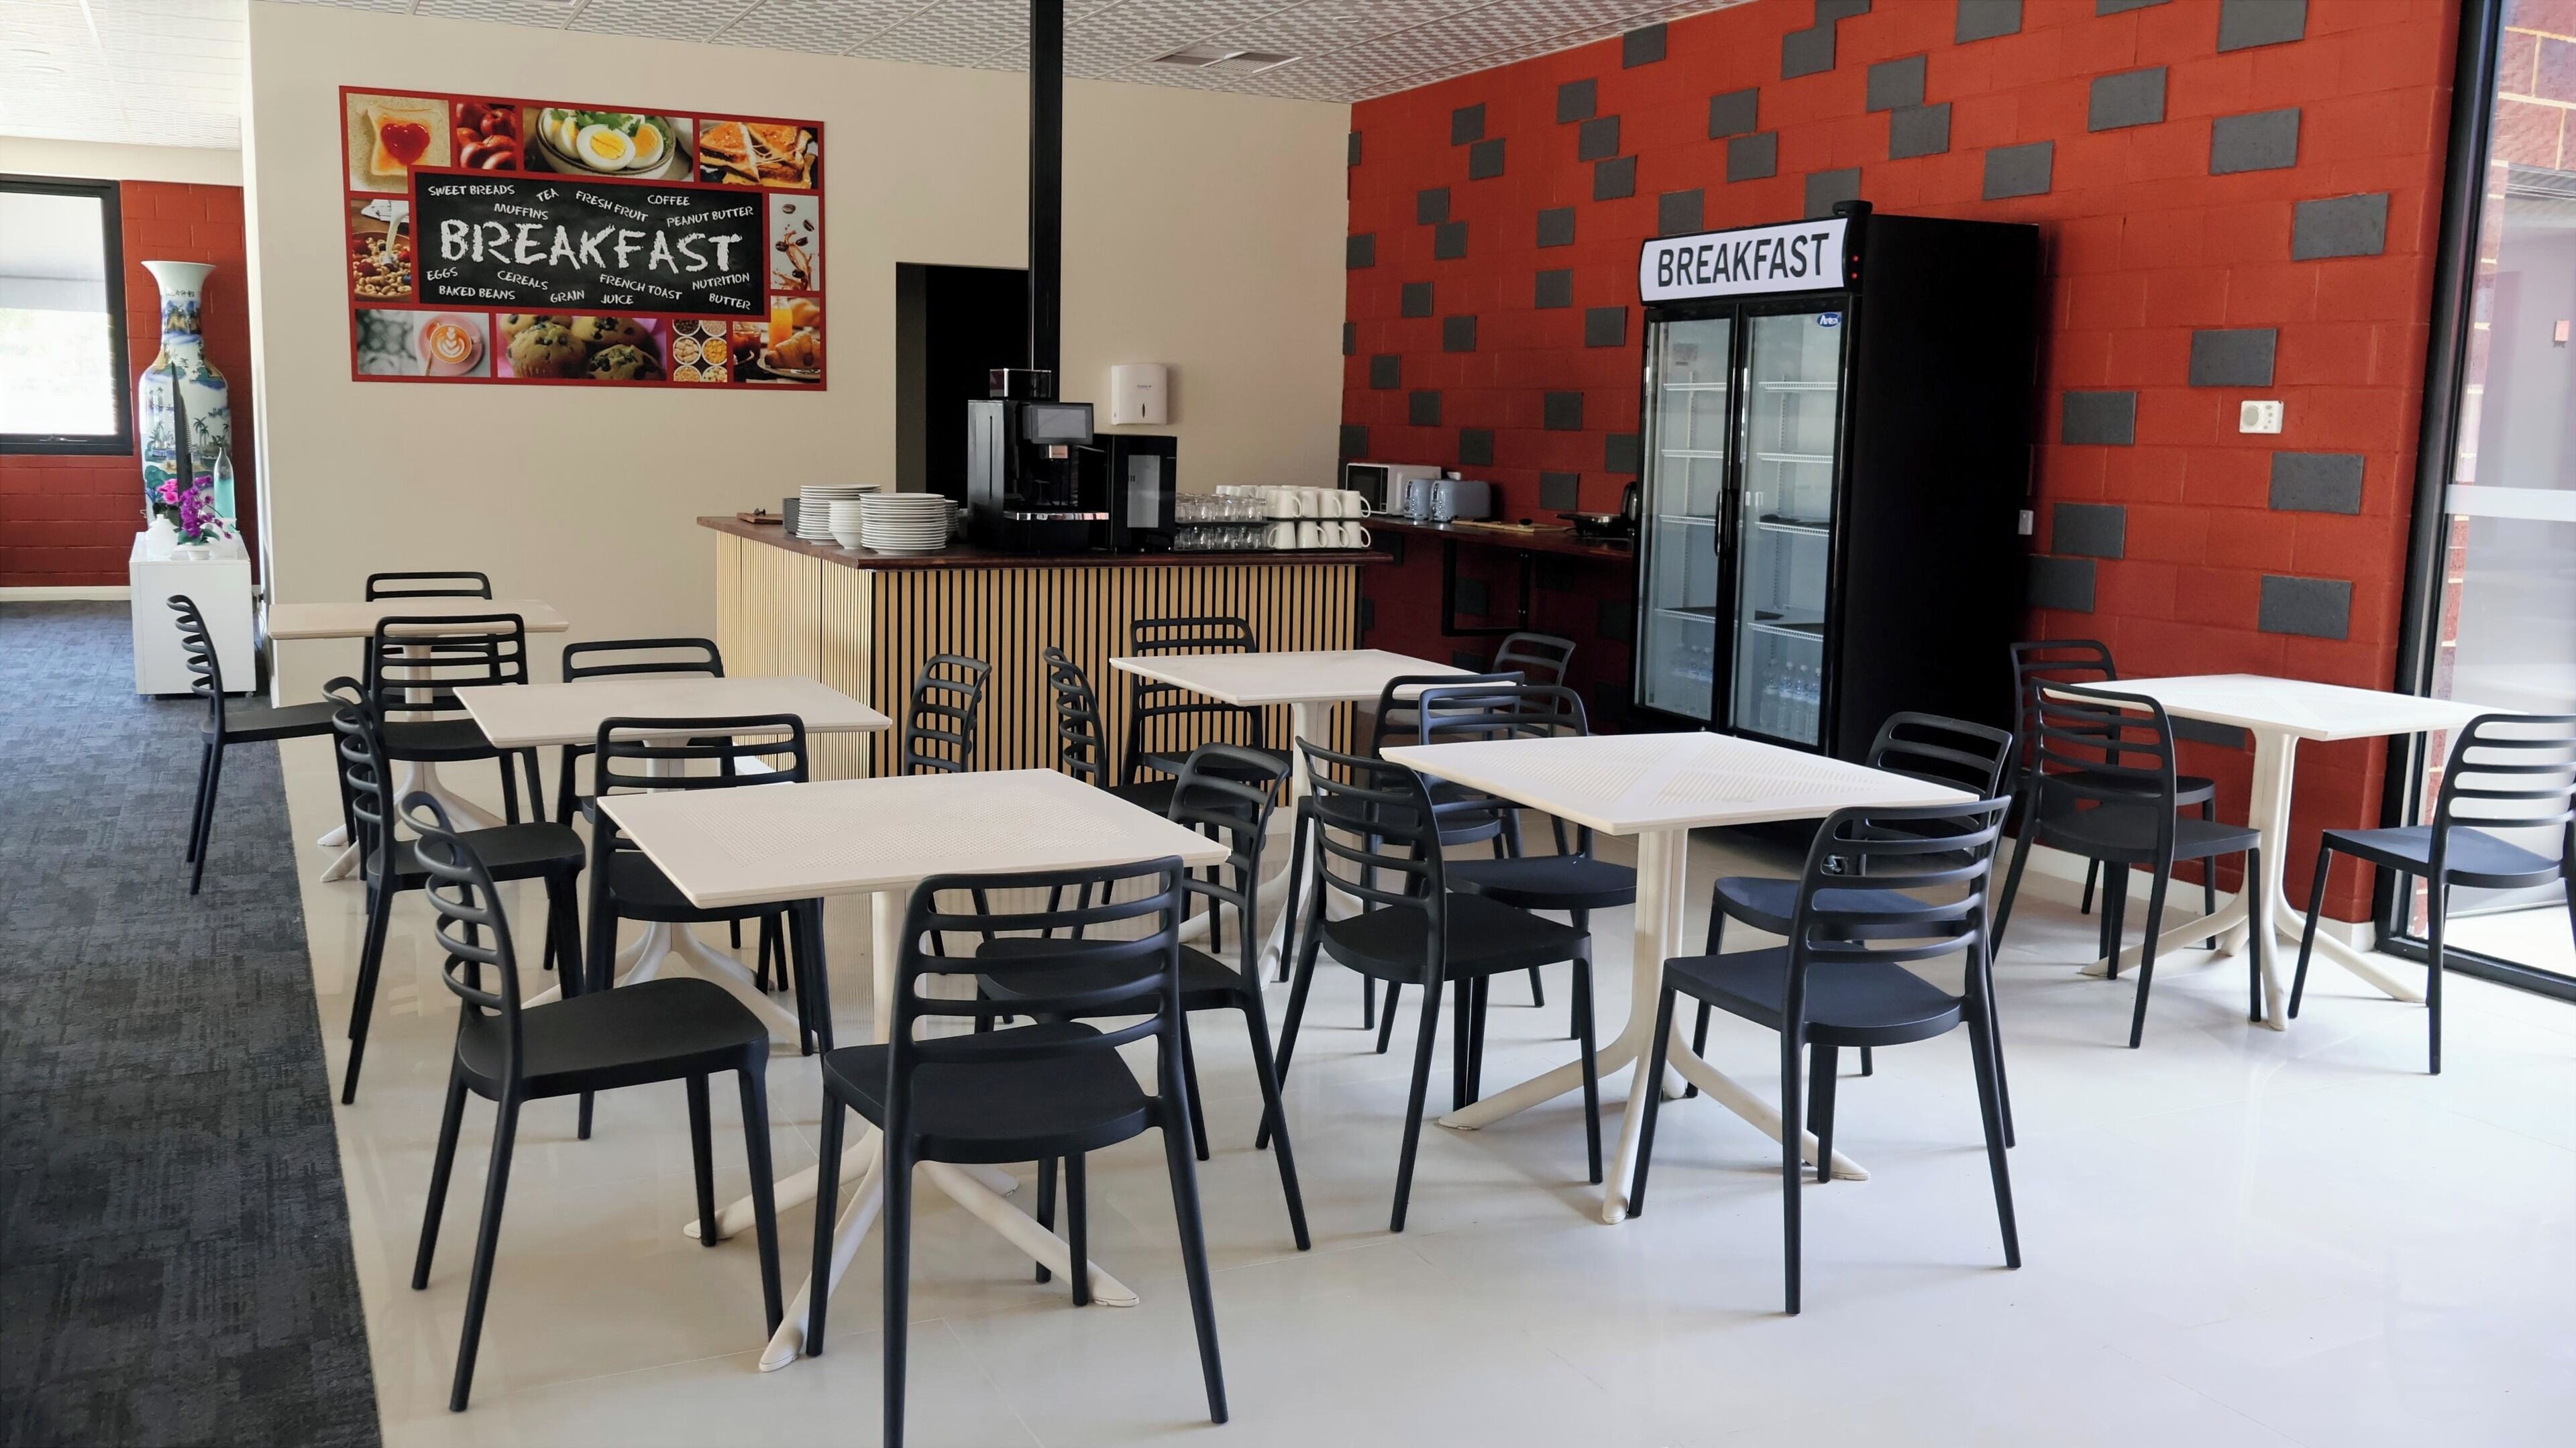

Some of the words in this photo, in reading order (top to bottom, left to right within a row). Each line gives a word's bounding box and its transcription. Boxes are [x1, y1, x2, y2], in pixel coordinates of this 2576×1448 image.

[428, 185, 467, 197] SWEET
[470, 184, 515, 195] BREADS
[536, 188, 559, 202] TEA
[576, 190, 612, 210] FRESH
[614, 204, 649, 222] FRUIT
[647, 194, 690, 206] COFFEE
[494, 203, 549, 220] MUFFINS
[666, 212, 709, 227] PEANUT
[712, 206, 753, 221] BUTTER
[440, 219, 743, 274] BREAKFAST
[1658, 233, 1829, 287] BREAKFAST
[427, 266, 458, 281] EGGS
[497, 270, 549, 290] CEREALS
[692, 272, 749, 290] NUTRITION
[439, 285, 476, 296] BAKED
[478, 288, 516, 300] BEANS
[599, 274, 646, 292] FRENCH
[648, 285, 682, 300] TOAST
[550, 290, 585, 303] GRAIN
[600, 294, 634, 304] JUICE
[709, 293, 751, 310] BUTTER
